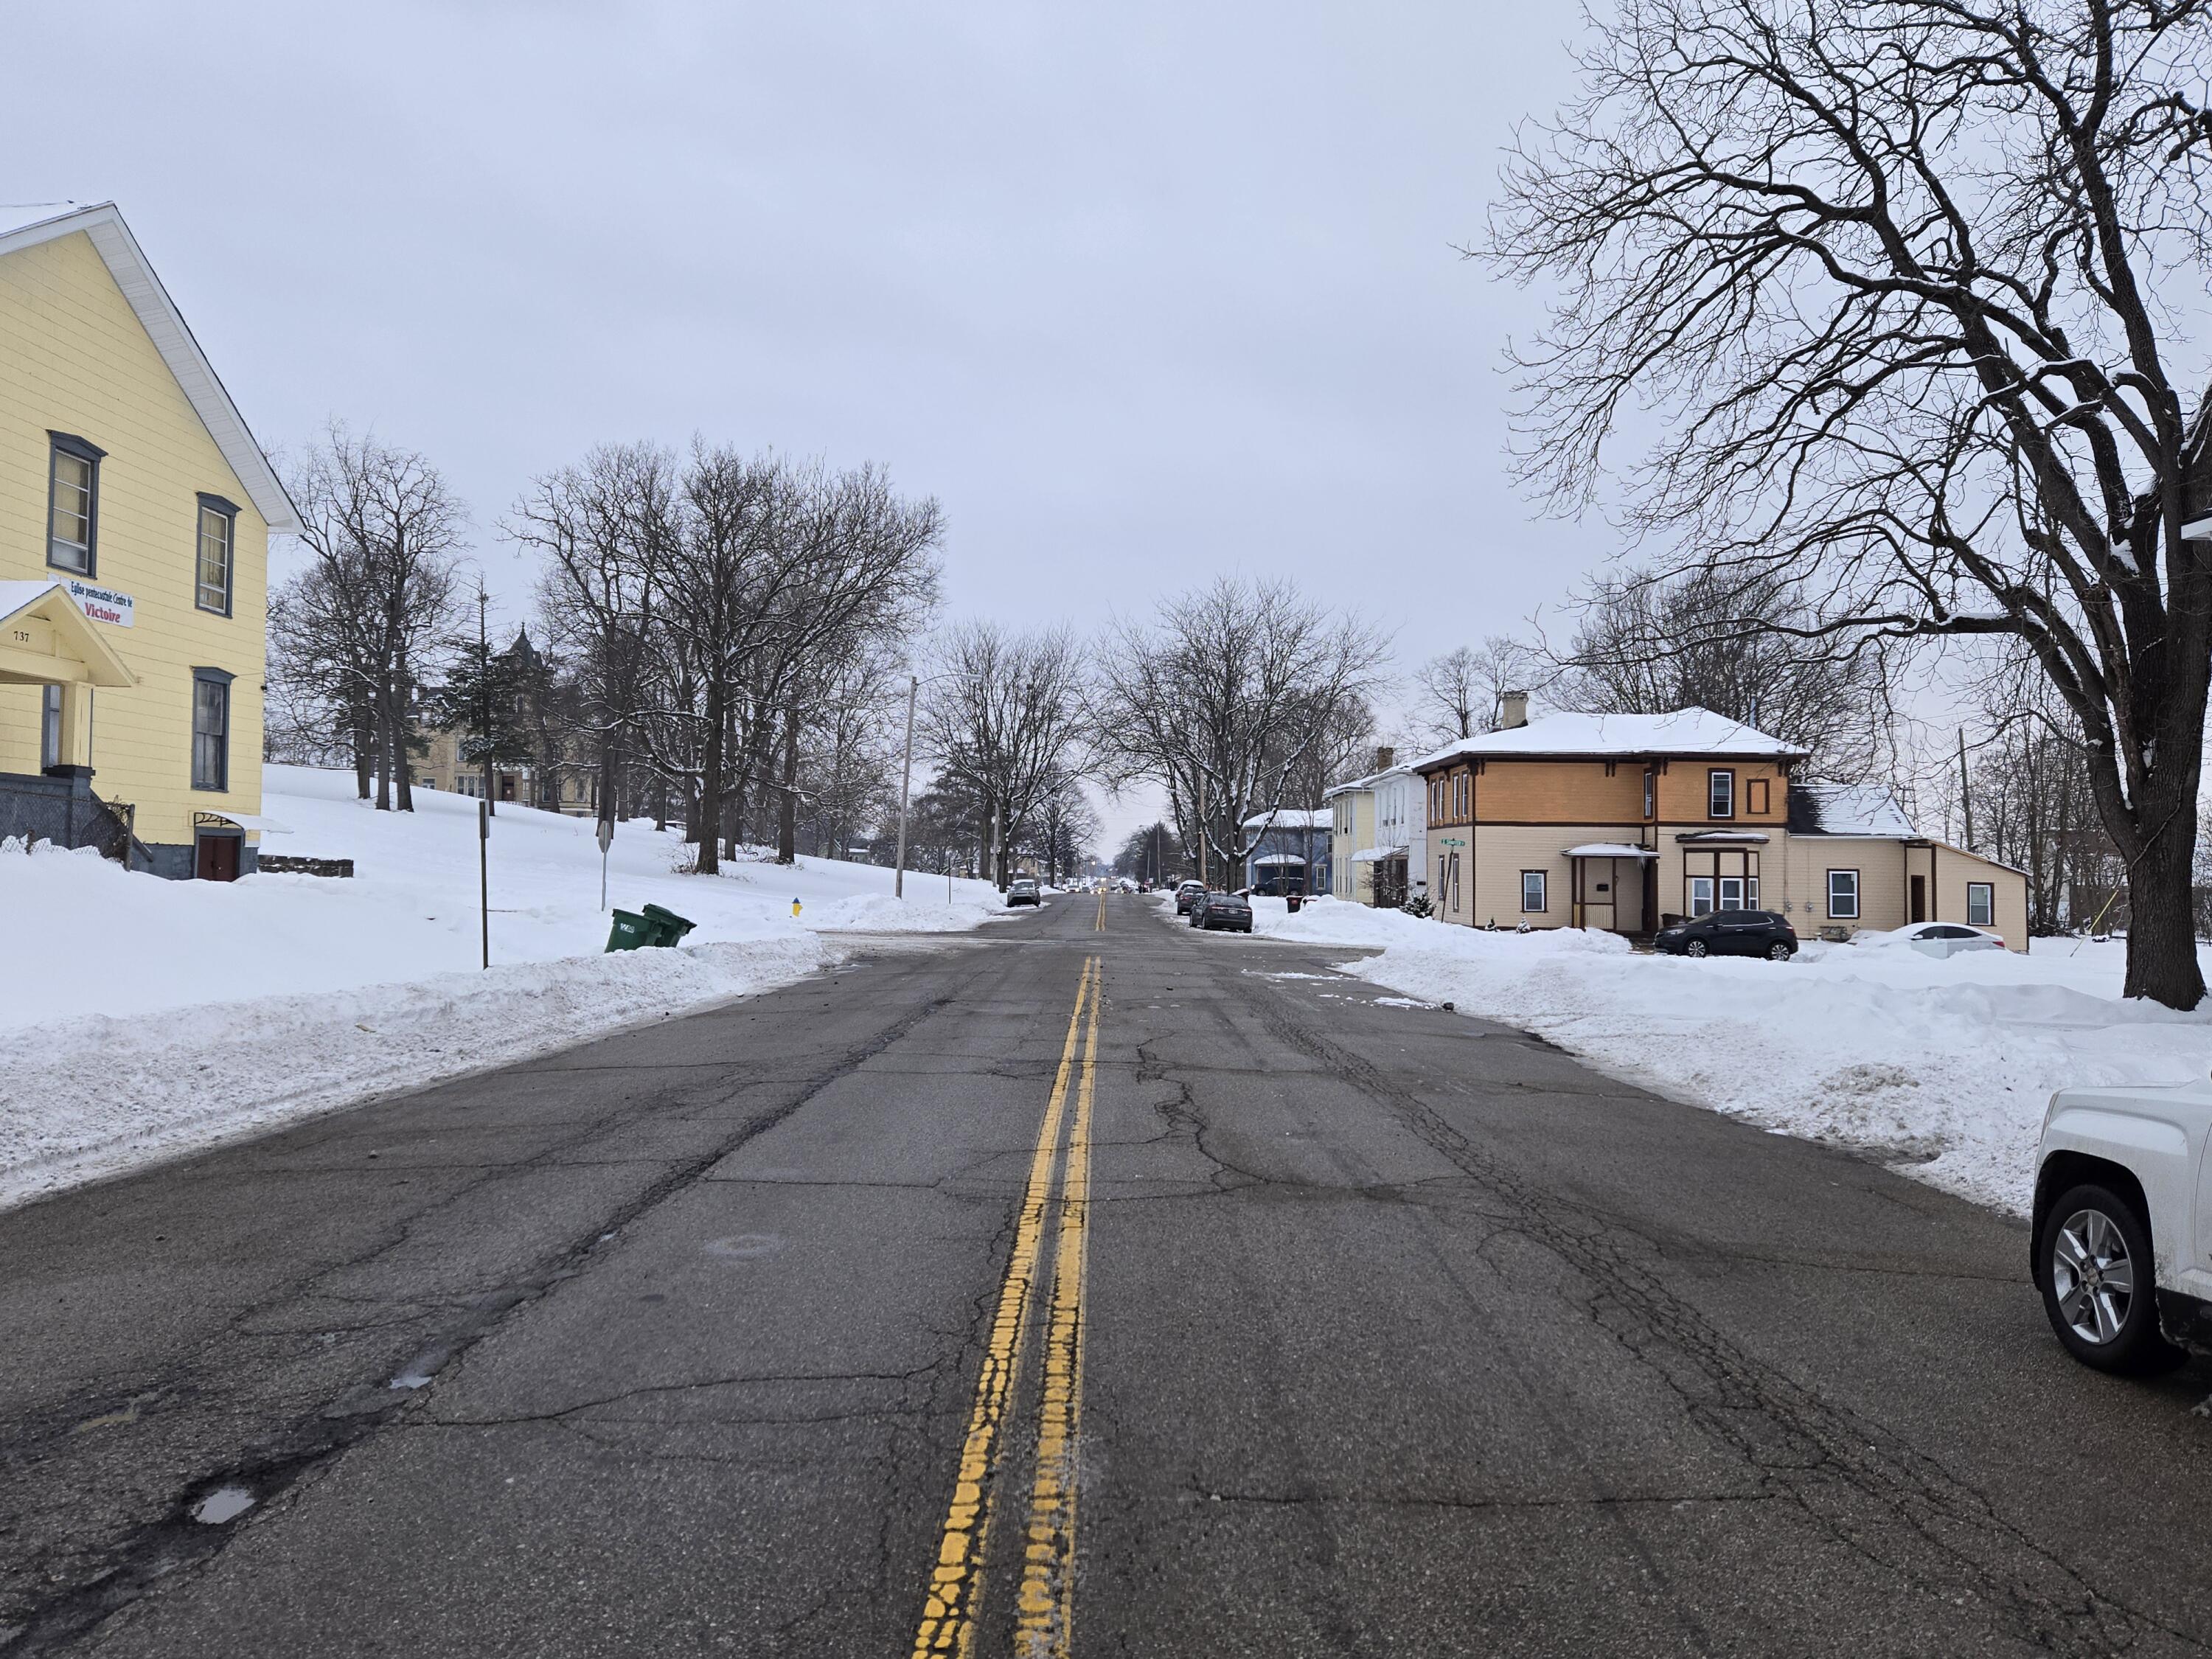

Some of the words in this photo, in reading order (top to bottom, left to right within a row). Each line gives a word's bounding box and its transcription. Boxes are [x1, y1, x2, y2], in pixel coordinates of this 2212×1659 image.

[113, 593, 127, 606] Centre
[127, 596, 133, 608] de
[85, 602, 120, 623] Victoire
[13, 630, 29, 642] 737
